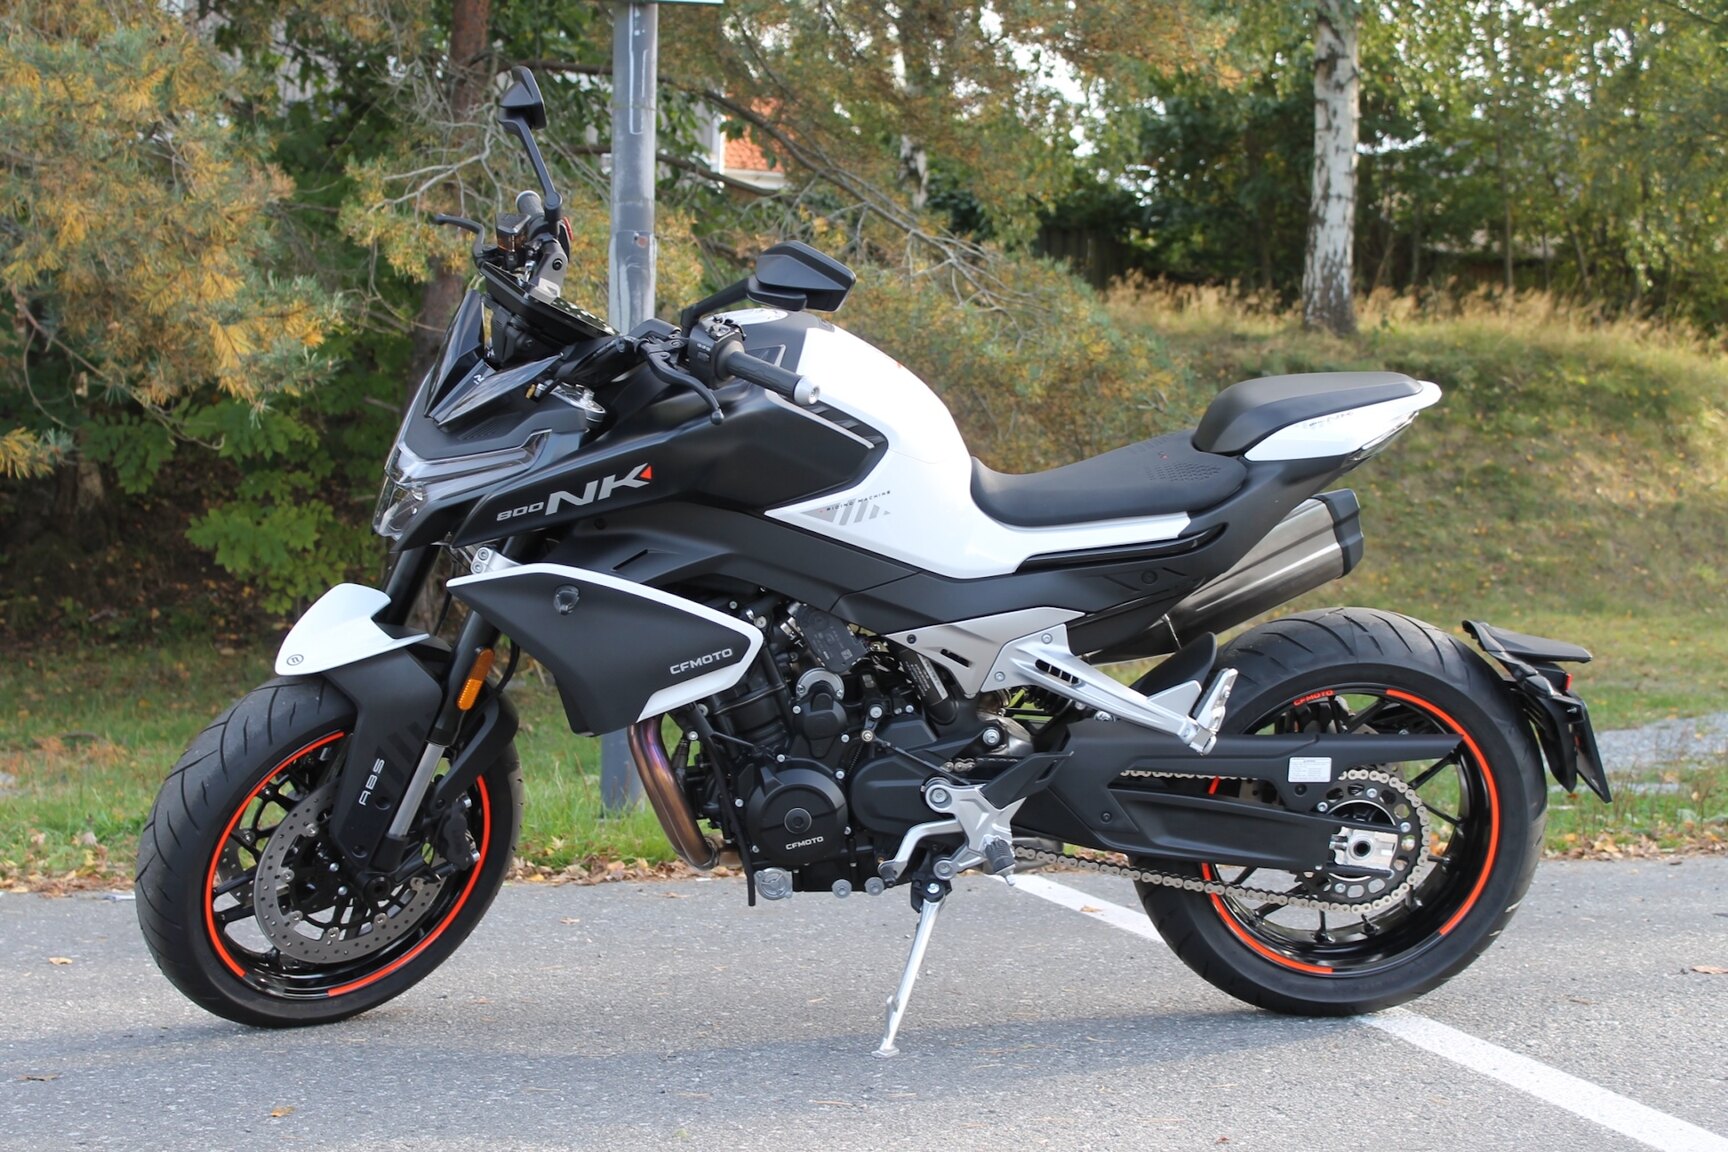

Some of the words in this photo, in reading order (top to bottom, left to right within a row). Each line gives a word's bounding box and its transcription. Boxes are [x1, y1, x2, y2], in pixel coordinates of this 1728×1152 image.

[496, 501, 545, 522] 800
[545, 462, 651, 516] NK
[669, 648, 733, 675] CFMOTO
[1293, 689, 1335, 706] CFMOTO
[358, 758, 385, 806] ABS
[785, 836, 824, 850] CFMOTO
